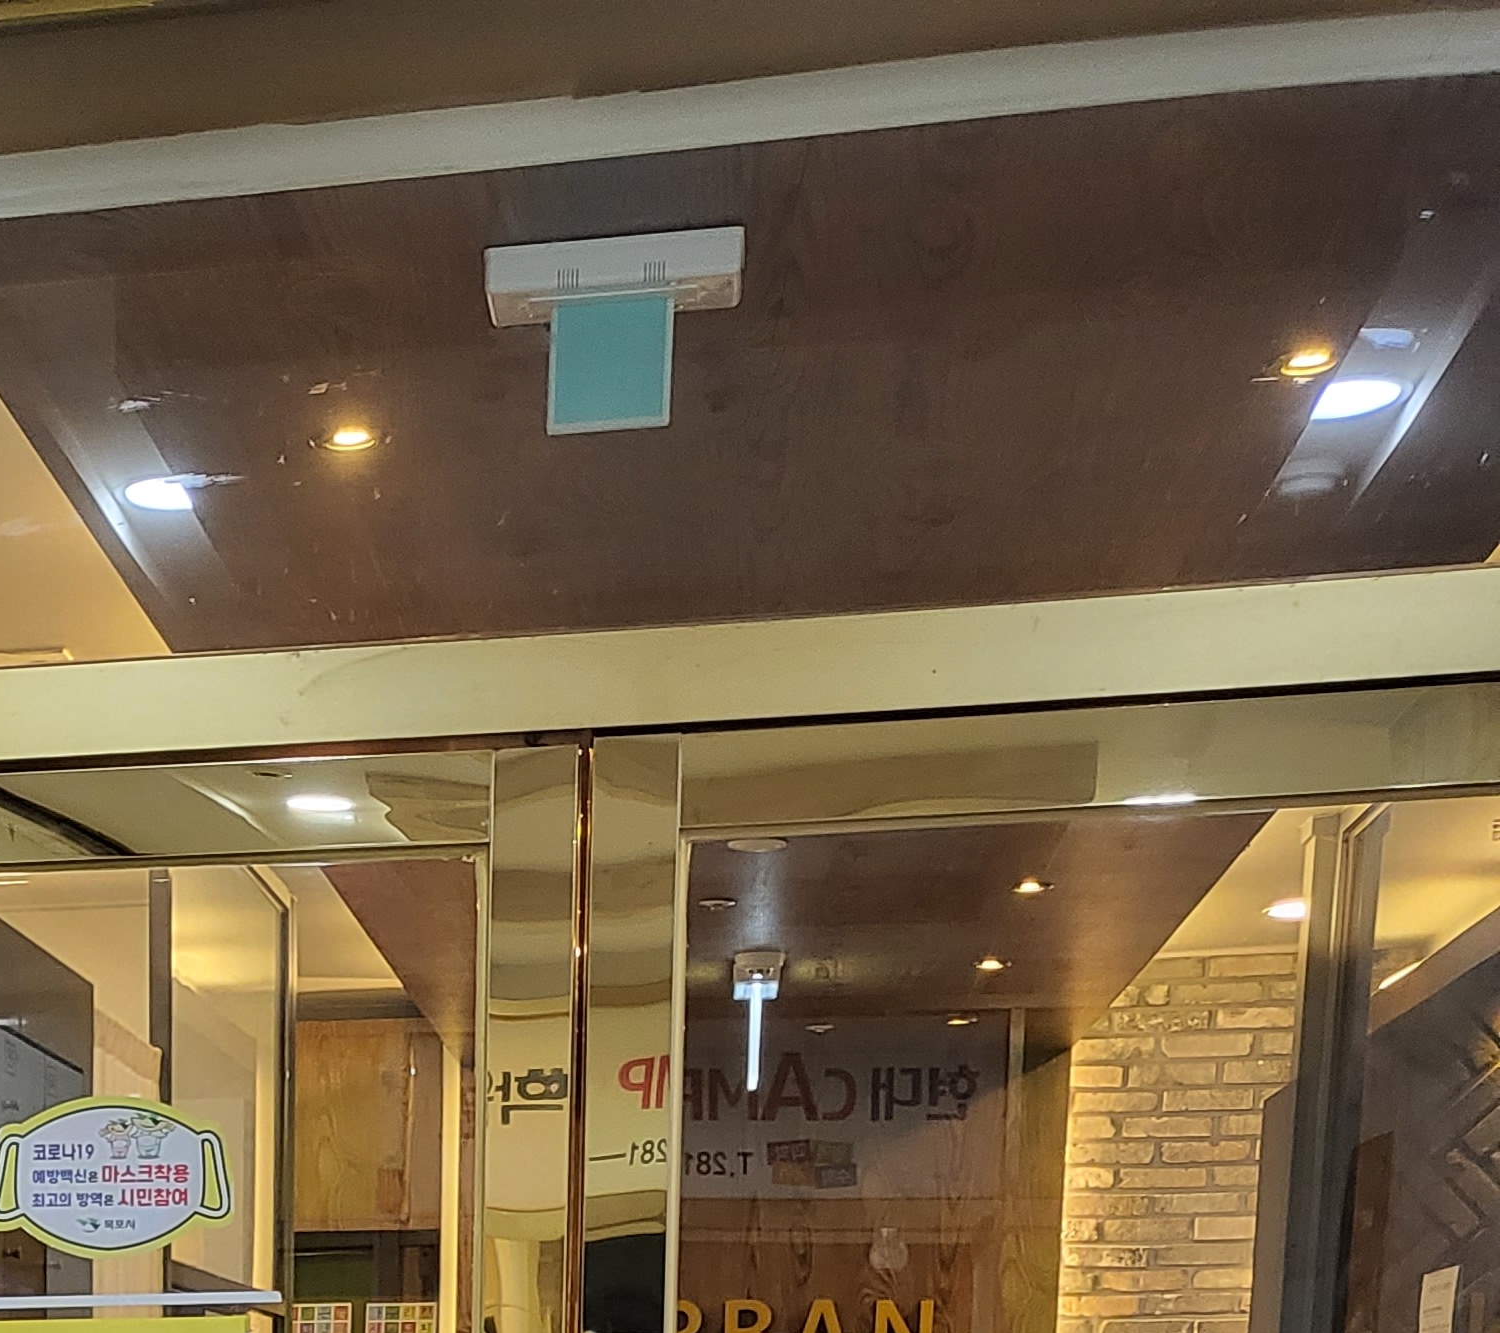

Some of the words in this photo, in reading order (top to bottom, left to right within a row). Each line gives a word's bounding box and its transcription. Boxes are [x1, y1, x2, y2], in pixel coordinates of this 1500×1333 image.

[33, 1143, 95, 1161] 코로나19
[32, 1169, 98, 1184] 예방백신은
[102, 1164, 190, 1184] 마스크착용
[32, 1192, 72, 1208] 최고의
[76, 1192, 114, 1207] 방역은
[118, 1188, 189, 1207] 시민참여
[104, 1218, 136, 1230] 목포시
